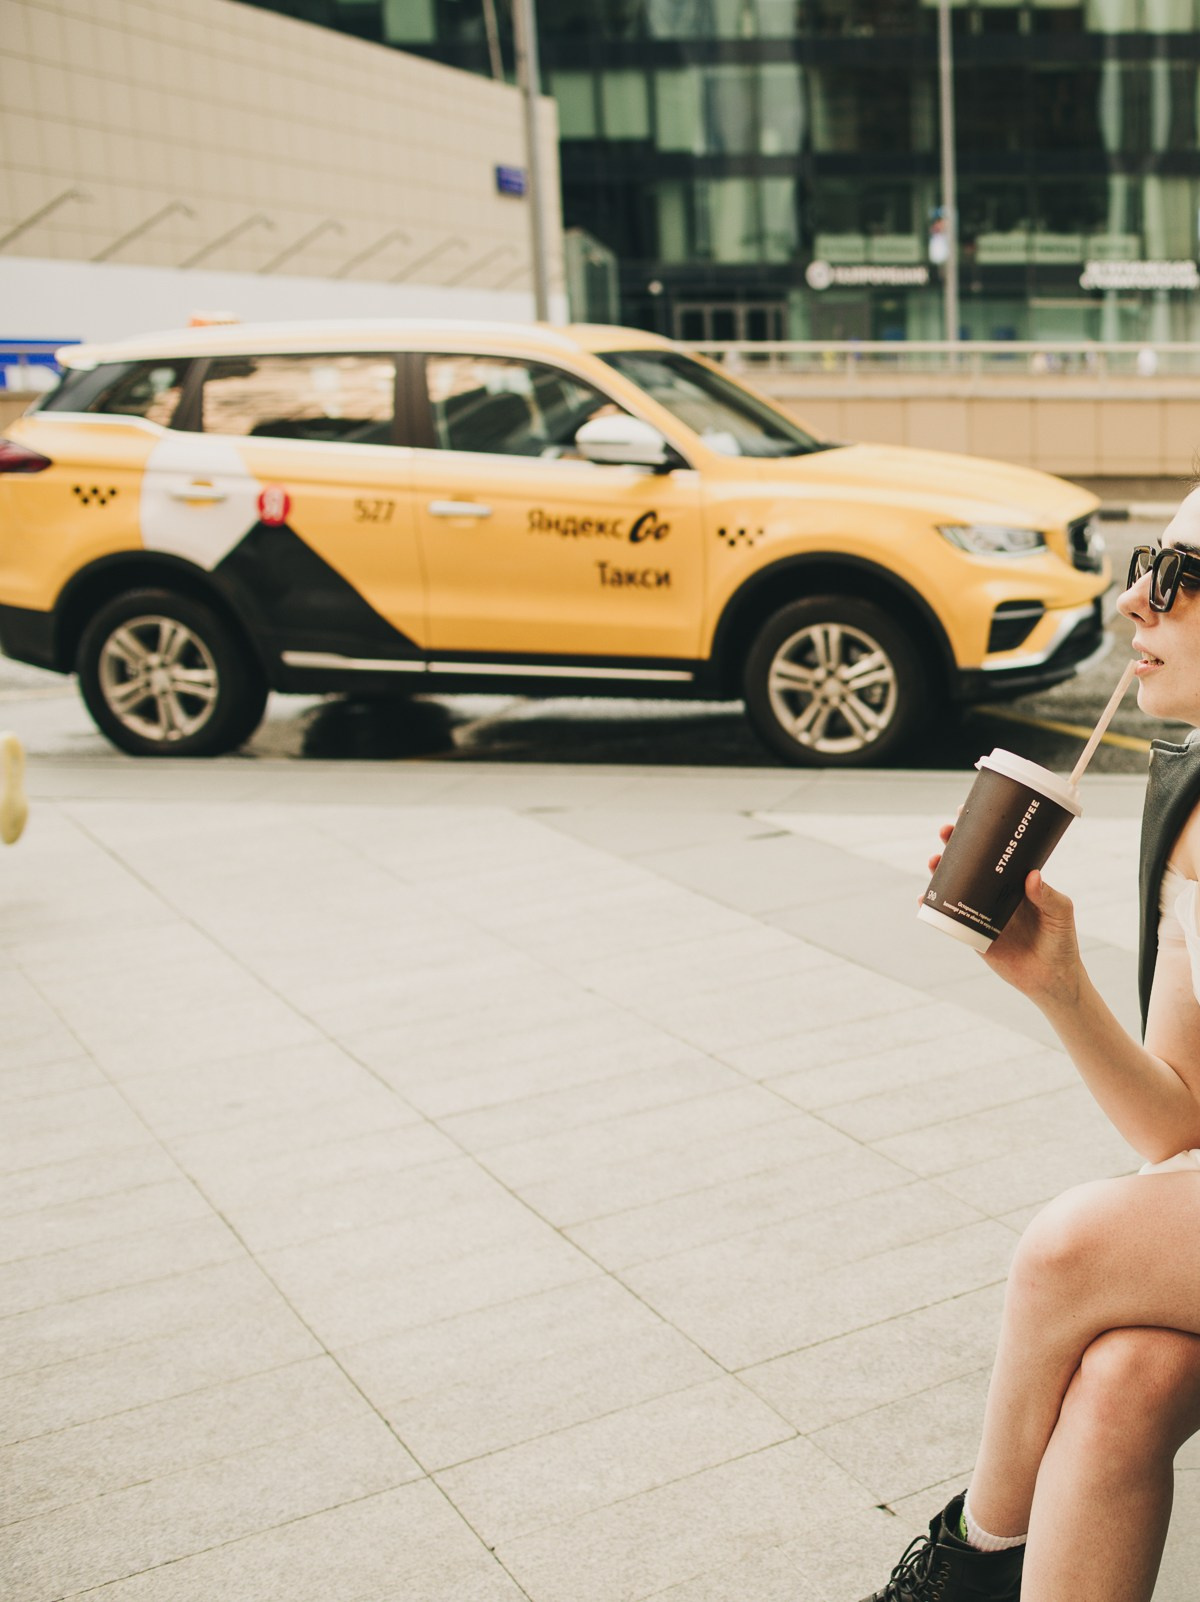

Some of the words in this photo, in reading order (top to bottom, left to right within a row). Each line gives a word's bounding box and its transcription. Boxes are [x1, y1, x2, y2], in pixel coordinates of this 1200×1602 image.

[353, 498, 396, 524] 527
[528, 508, 624, 539] Яндекс
[595, 560, 671, 589] Такси
[995, 840, 1018, 874] STARS
[1014, 799, 1040, 839] COFFEE
